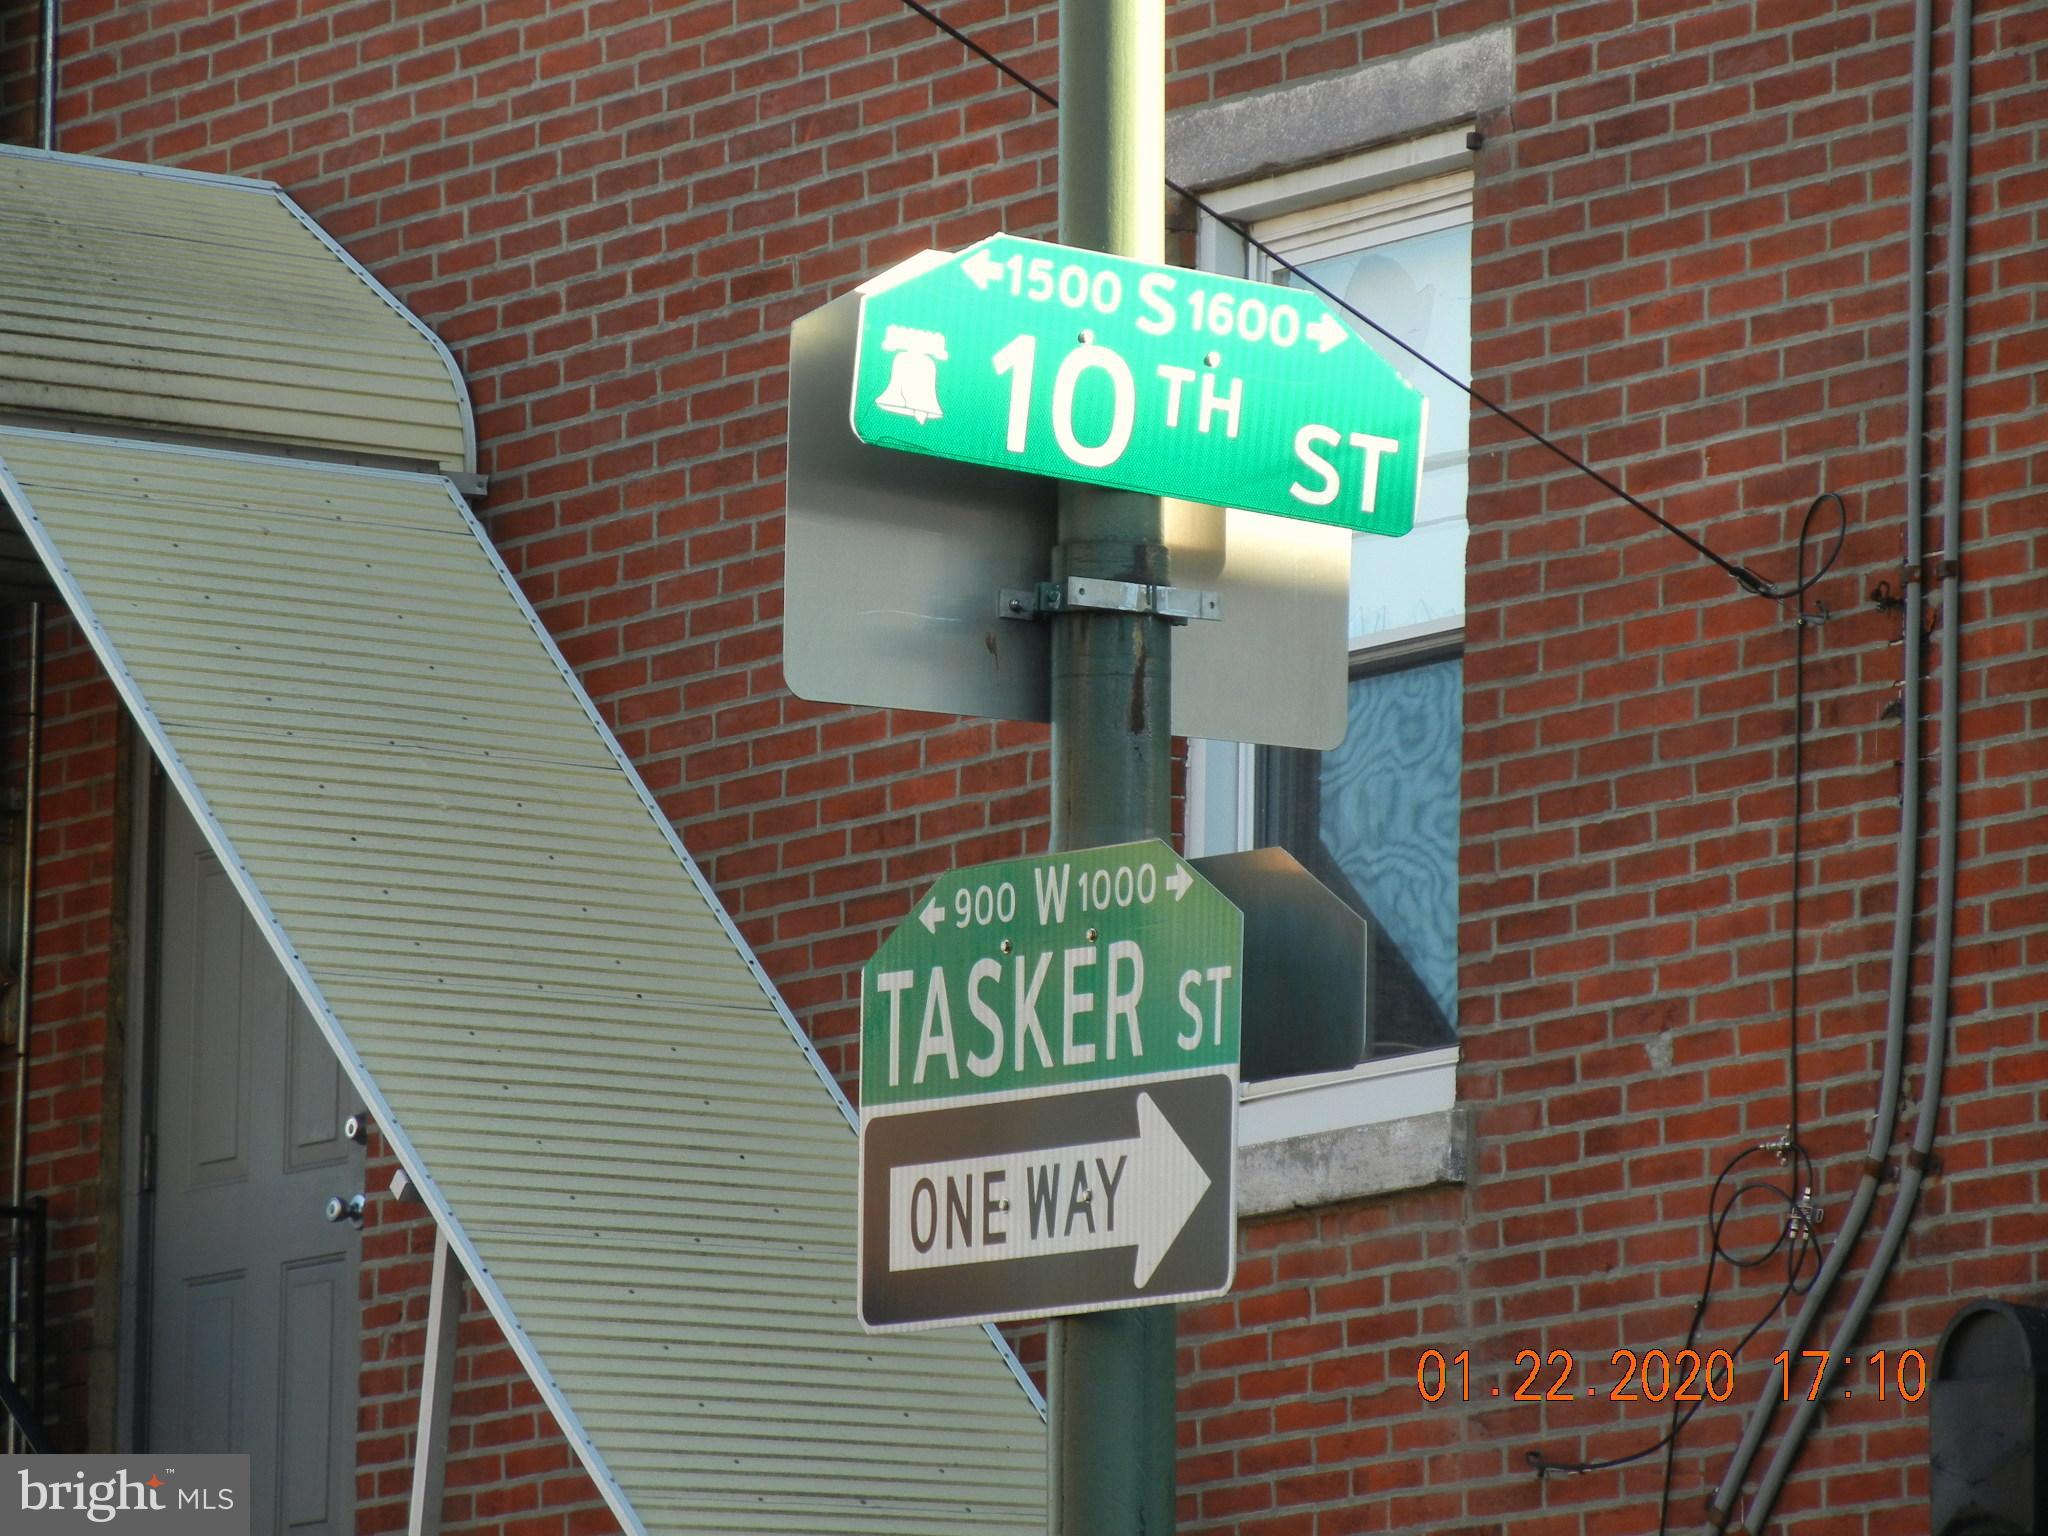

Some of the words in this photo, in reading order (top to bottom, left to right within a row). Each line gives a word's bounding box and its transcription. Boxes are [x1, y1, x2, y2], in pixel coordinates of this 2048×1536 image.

[1007, 254, 1123, 314] 1500
[1136, 272, 1178, 336] S
[1189, 289, 1300, 348] 1600
[1289, 423, 1400, 513] ST
[954, 881, 1016, 929] 900
[1034, 863, 1071, 926] W
[1078, 863, 1157, 912] 1000
[877, 940, 1145, 1087] TASKER
[1177, 965, 1232, 1051] ST
[910, 1169, 1007, 1254] ONE
[1026, 1155, 1128, 1241] WAY
